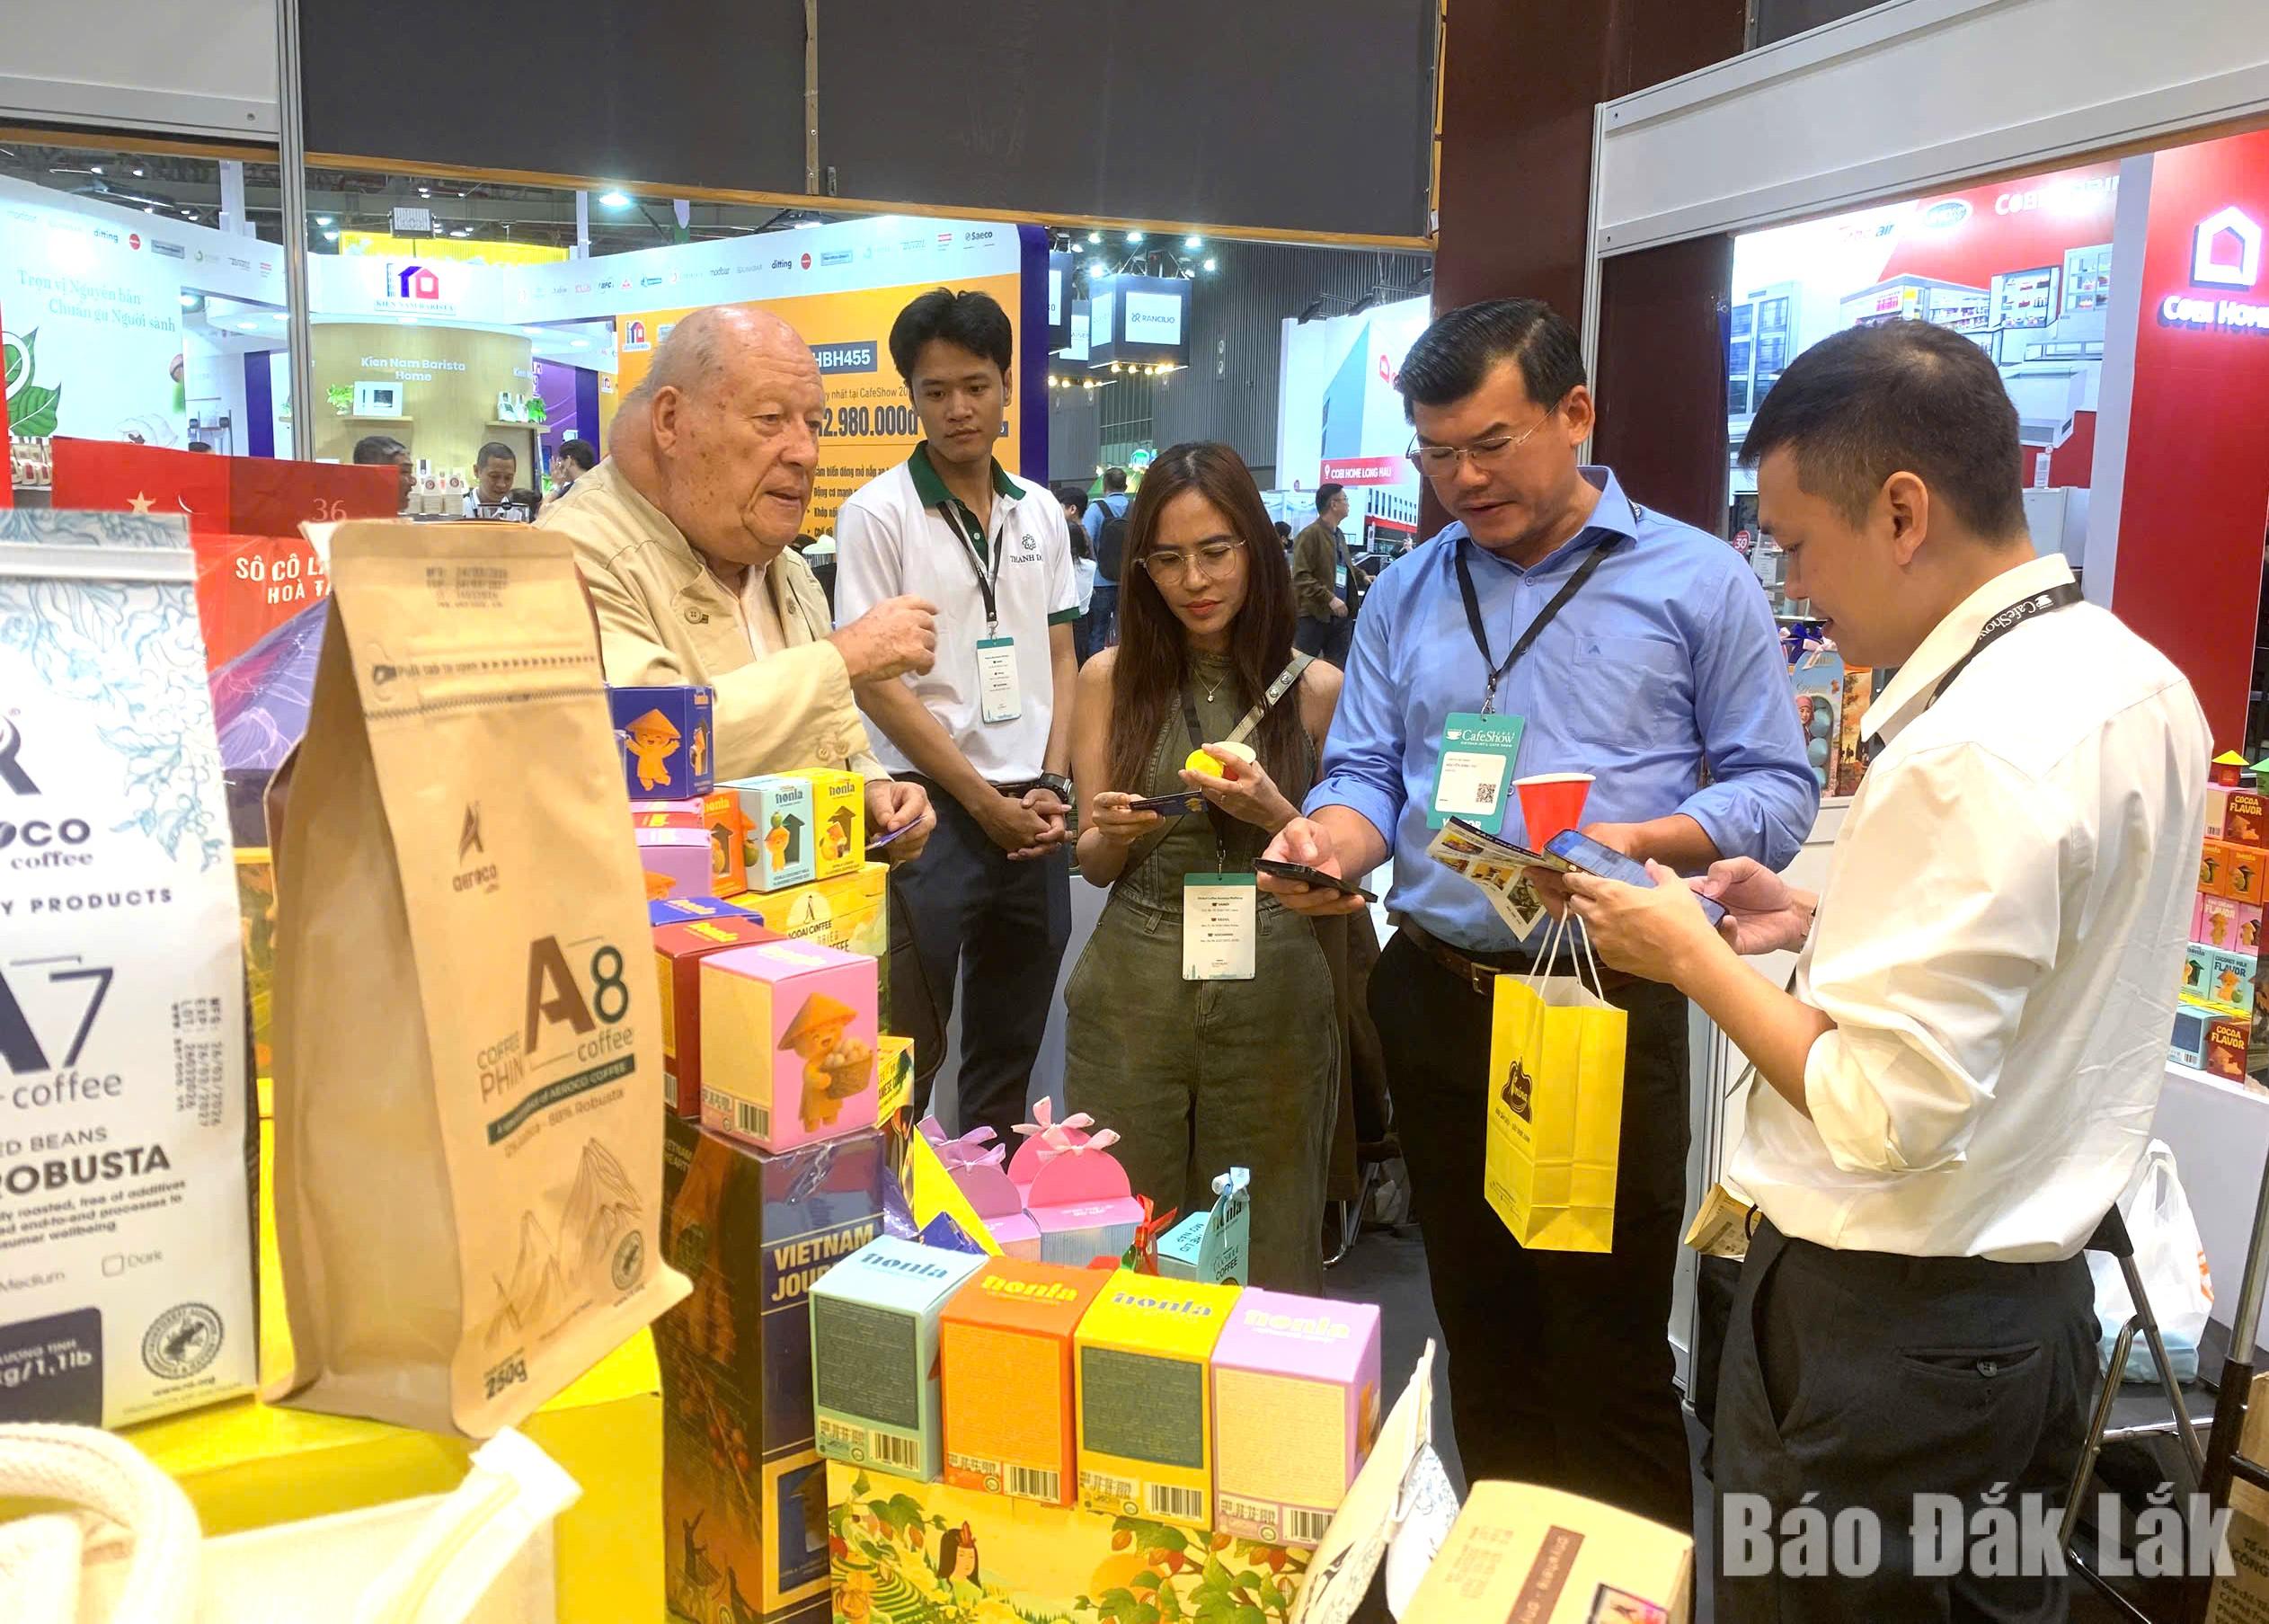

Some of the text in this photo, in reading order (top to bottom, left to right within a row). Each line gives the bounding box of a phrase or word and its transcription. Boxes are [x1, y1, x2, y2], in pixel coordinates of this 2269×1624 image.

[971, 230, 993, 241] Saeco
[771, 259, 793, 271] ditting
[2218, 299, 2269, 329] HOM
[361, 357, 465, 371] Kien Nam Barista
[395, 370, 431, 382] Home
[859, 386, 898, 398] CafeShow
[1346, 467, 1361, 479] HOME
[1362, 466, 1378, 478] LONG
[312, 498, 347, 522] 36
[1734, 537, 1747, 549] 30
[235, 555, 265, 581] SÔ
[271, 553, 300, 581] CÔ
[268, 578, 306, 604] HOÀ
[1462, 729, 1515, 743] CafeShow
[776, 788, 803, 804] nonla
[829, 782, 855, 796] nonla
[2229, 803, 2263, 816] FLAVOR
[2235, 795, 2259, 806] COCOA
[11, 851, 94, 871] coffee
[31, 888, 173, 914] PRODUCTS
[2205, 904, 2236, 919] FLAVOR
[2214, 962, 2247, 978] FLAVOR
[524, 934, 629, 1056] A8
[2211, 1032, 2245, 1050] FLAVOR
[2216, 1025, 2241, 1039] COCOA
[577, 1026, 634, 1062] coffee
[12, 1069, 123, 1110] coffee
[479, 1055, 526, 1104] PHIN
[31, 1127, 108, 1151] BEANS
[0, 1144, 171, 1197] OBUSTA
[111, 1191, 124, 1202] of
[49, 1220, 118, 1241] wellbeing
[774, 1223, 874, 1272] VIETNAM
[860, 1252, 948, 1279] nonla
[1216, 1256, 1238, 1282] COFFEE
[981, 1274, 1078, 1302] nonla
[1112, 1290, 1212, 1317] nonla
[1244, 1308, 1351, 1339] nonla
[485, 1358, 527, 1400] 250g
